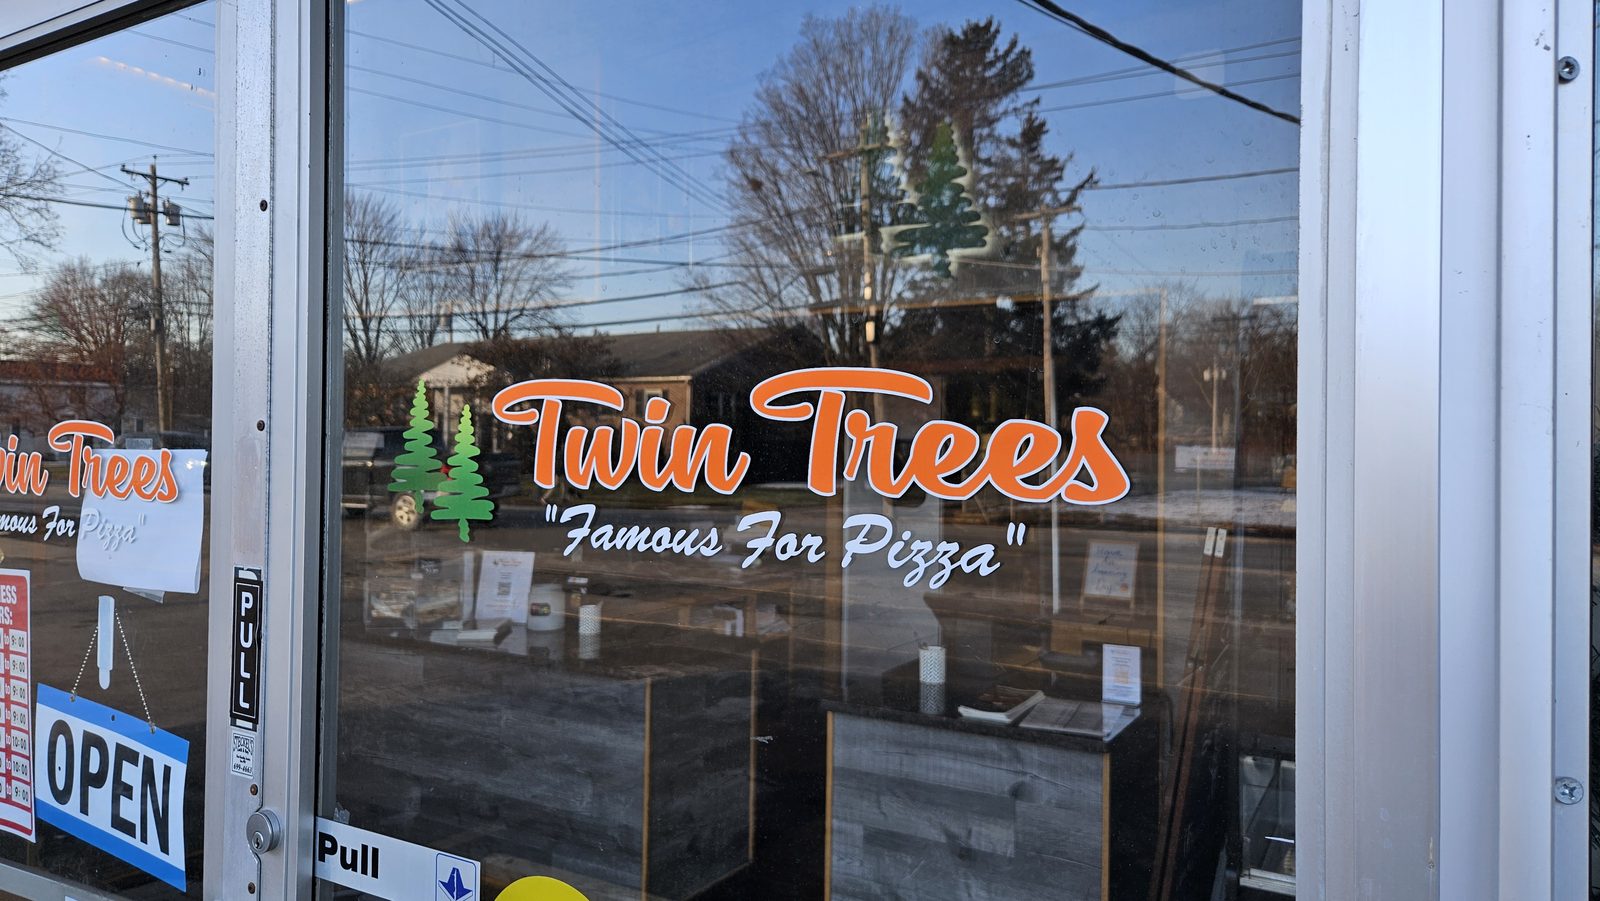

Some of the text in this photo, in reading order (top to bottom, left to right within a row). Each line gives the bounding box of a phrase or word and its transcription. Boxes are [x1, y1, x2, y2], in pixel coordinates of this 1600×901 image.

[48, 420, 179, 503] Trees
[492, 366, 1131, 506] Twin Trees
[42, 505, 76, 541] For
[80, 507, 146, 550] Pizza"
[545, 503, 1026, 589] "Famous For Pizza"
[239, 591, 254, 709] PULL
[47, 719, 172, 856] OPEN
[318, 831, 380, 879] Pull
